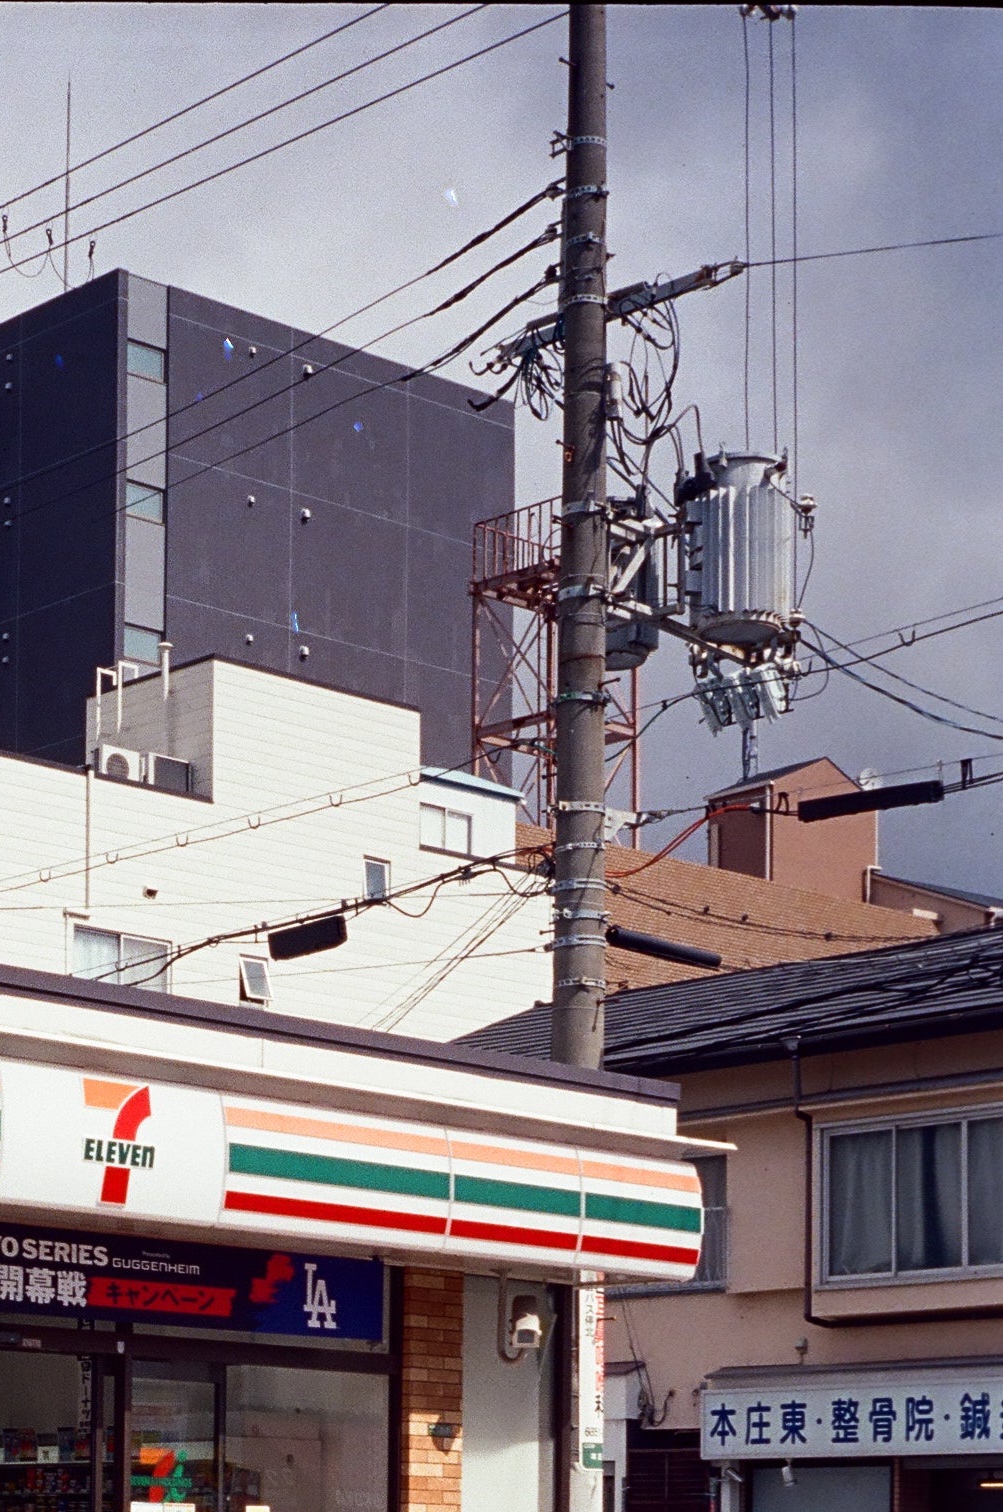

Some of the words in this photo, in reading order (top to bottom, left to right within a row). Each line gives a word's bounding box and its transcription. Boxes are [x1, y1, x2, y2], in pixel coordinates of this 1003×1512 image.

[23, 1238, 109, 1267] SERIES
[112, 1258, 200, 1275] GUGGENHEIM
[106, 1282, 217, 1310] キャンペーン
[304, 1263, 336, 1328] LA
[710, 1392, 1003, 1446] 本庄東・整骨院・鍼
